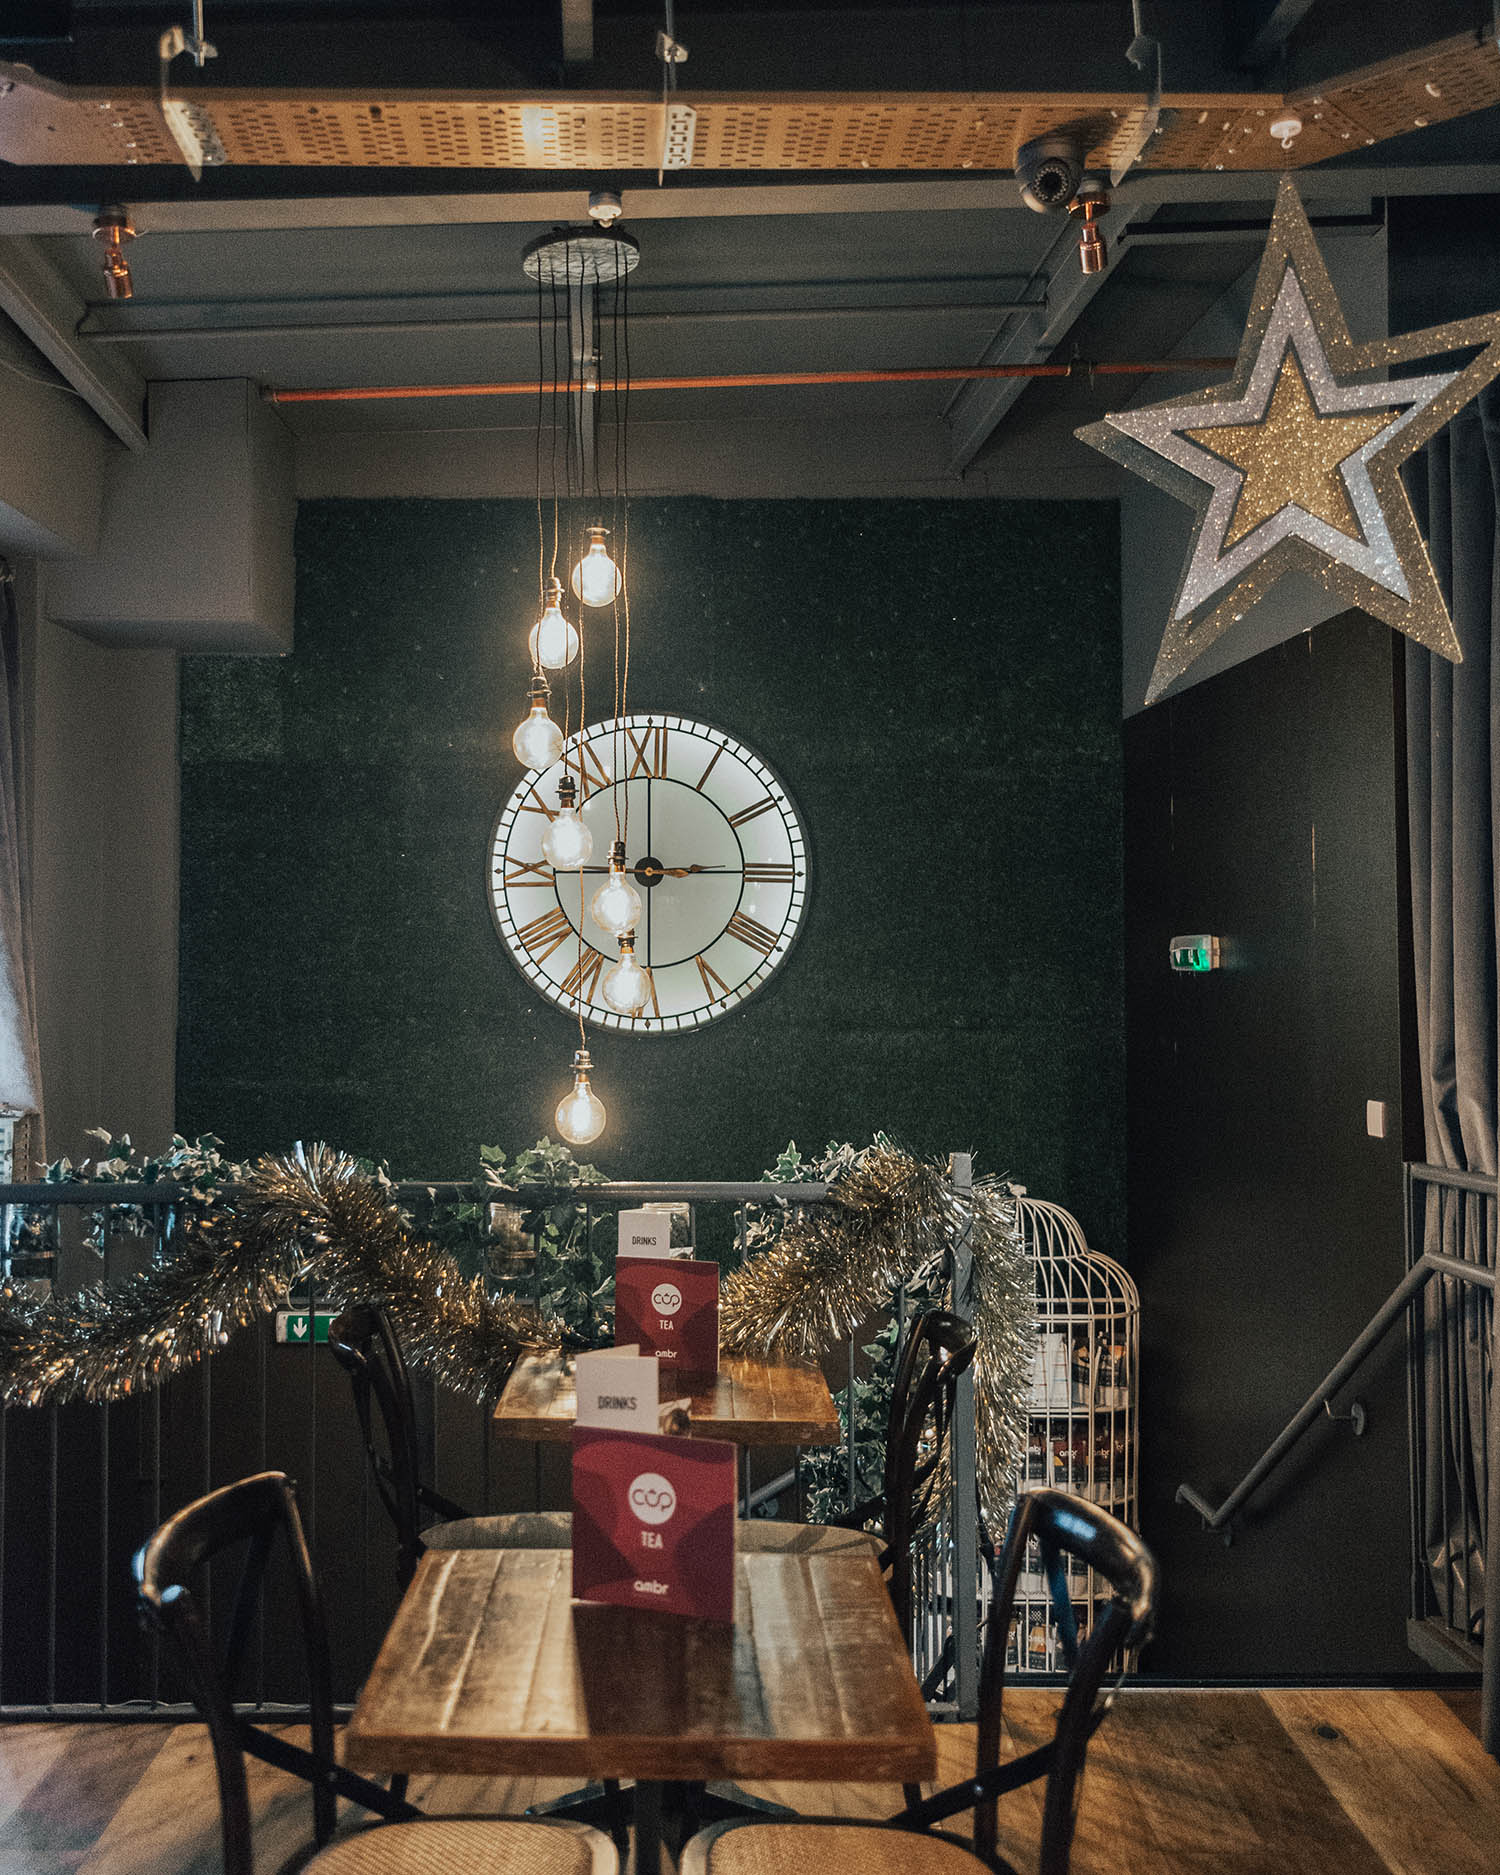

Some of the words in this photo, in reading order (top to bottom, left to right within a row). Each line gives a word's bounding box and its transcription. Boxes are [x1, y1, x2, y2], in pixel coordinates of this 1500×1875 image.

[626, 728, 667, 779] XII
[744, 863, 793, 883] III
[631, 1235, 657, 1246] DRINKS
[659, 1319, 674, 1331] TEA
[654, 1348, 678, 1359] ambr
[597, 1395, 638, 1410] DRINKS
[641, 1532, 664, 1550] TEA
[633, 1580, 669, 1595] ambr
